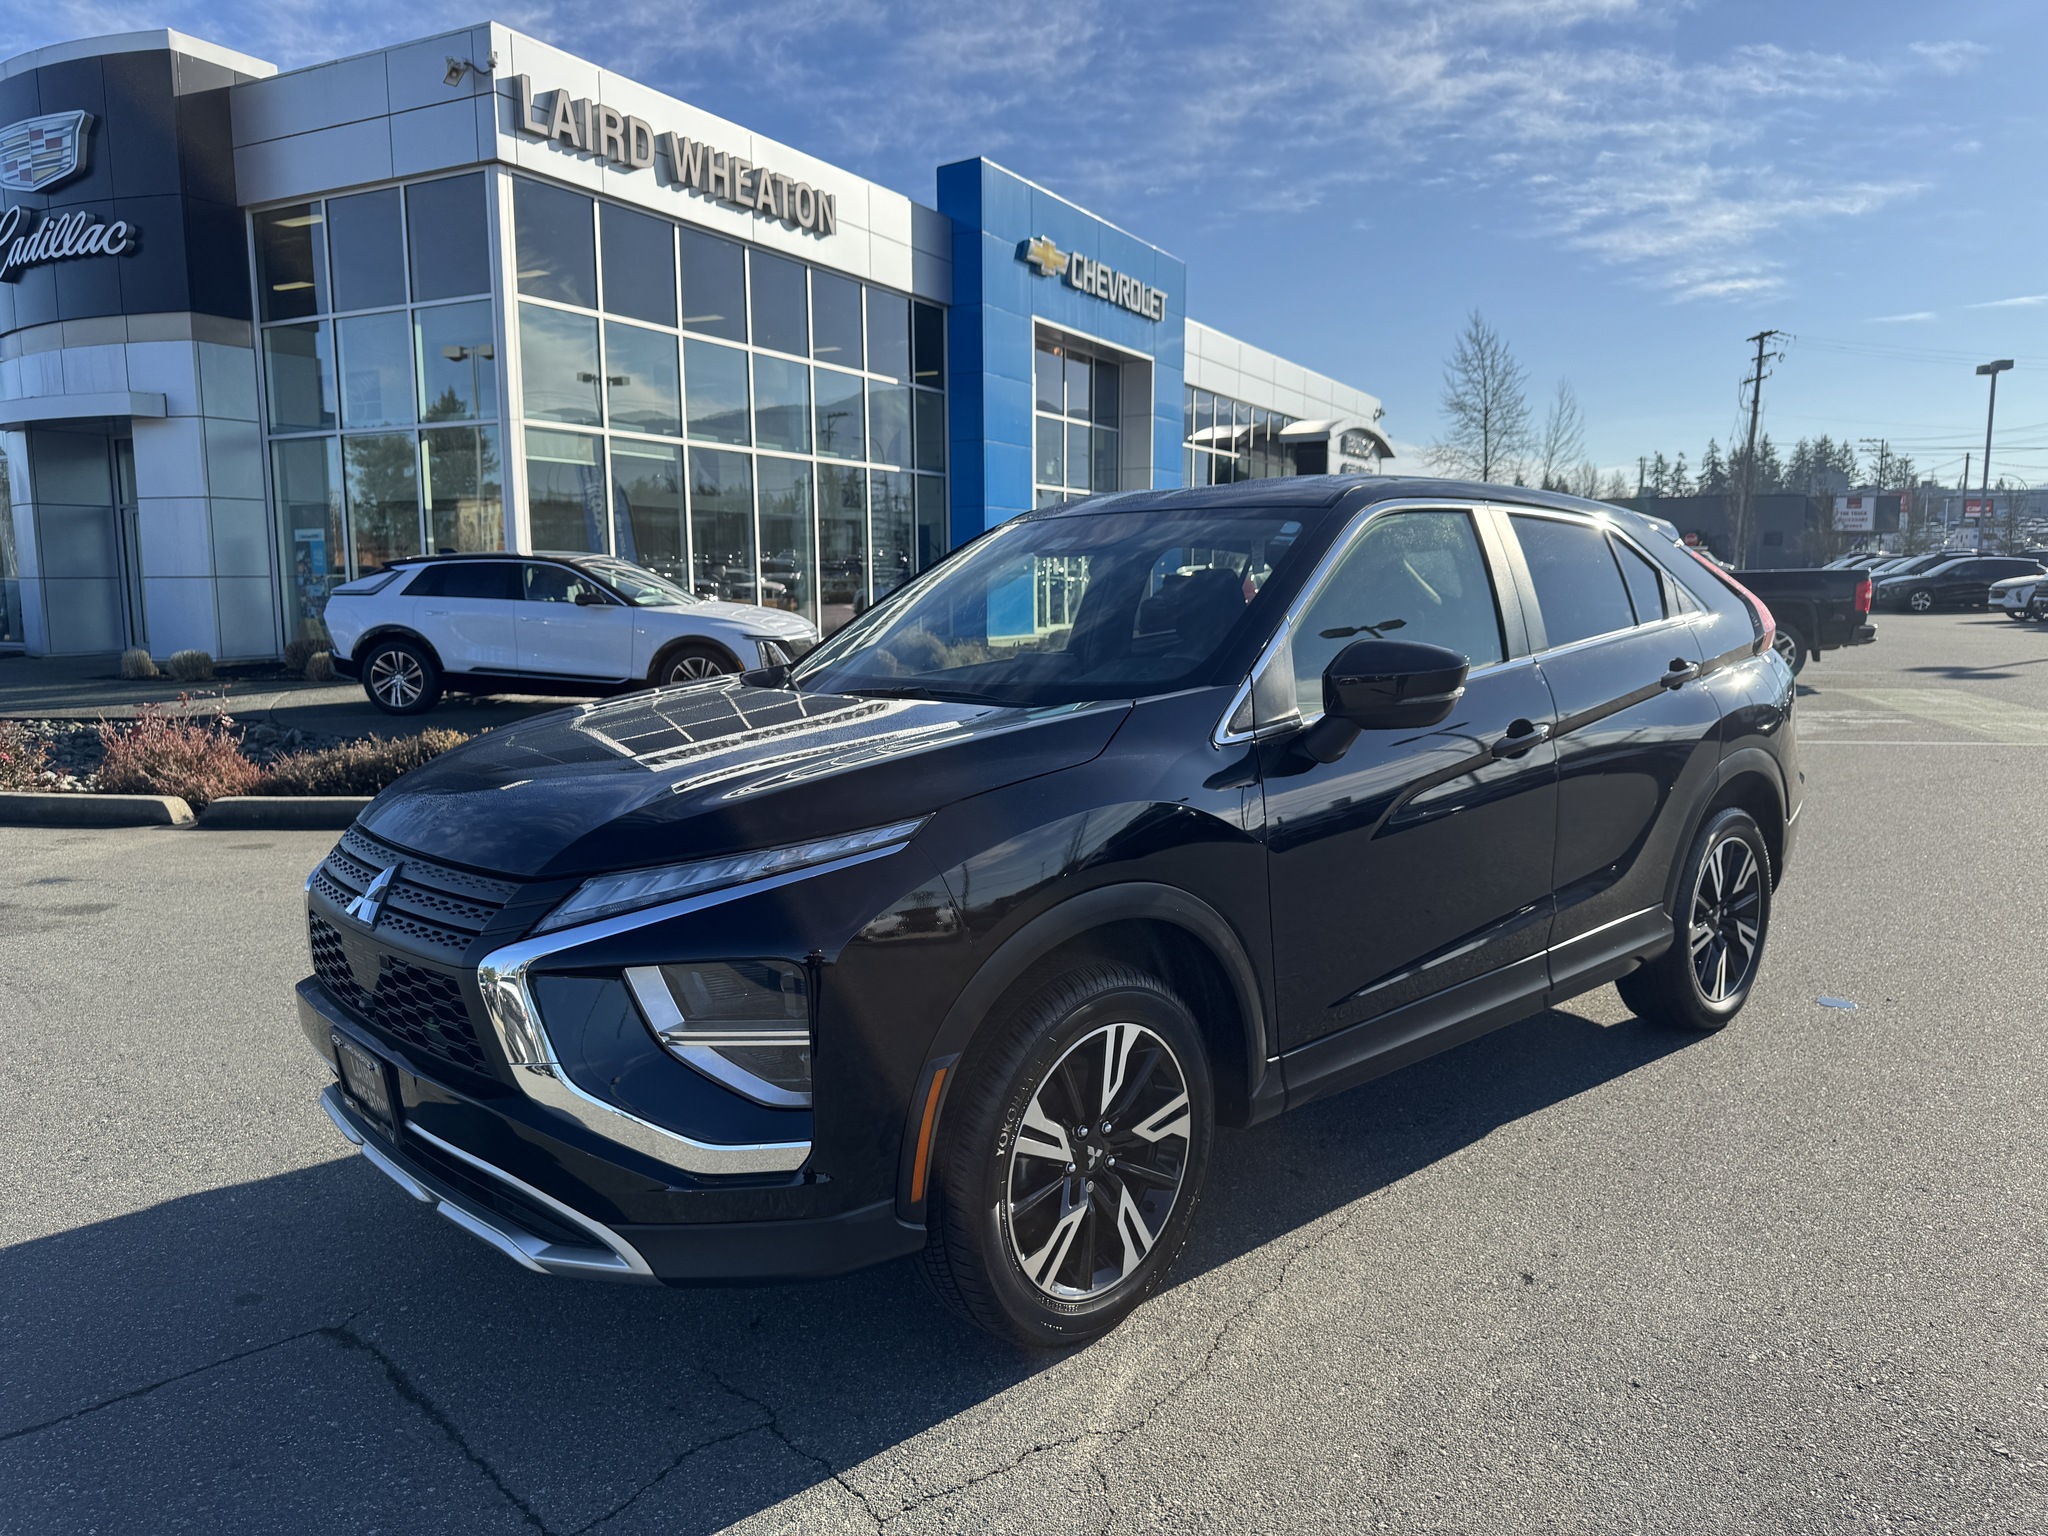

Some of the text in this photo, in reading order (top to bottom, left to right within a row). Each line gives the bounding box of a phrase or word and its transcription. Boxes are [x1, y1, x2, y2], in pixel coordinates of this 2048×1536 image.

[519, 73, 836, 236] LAIRD WHEATON
[0, 205, 128, 279] Cadillac
[1071, 252, 1168, 322] CHEVROLET
